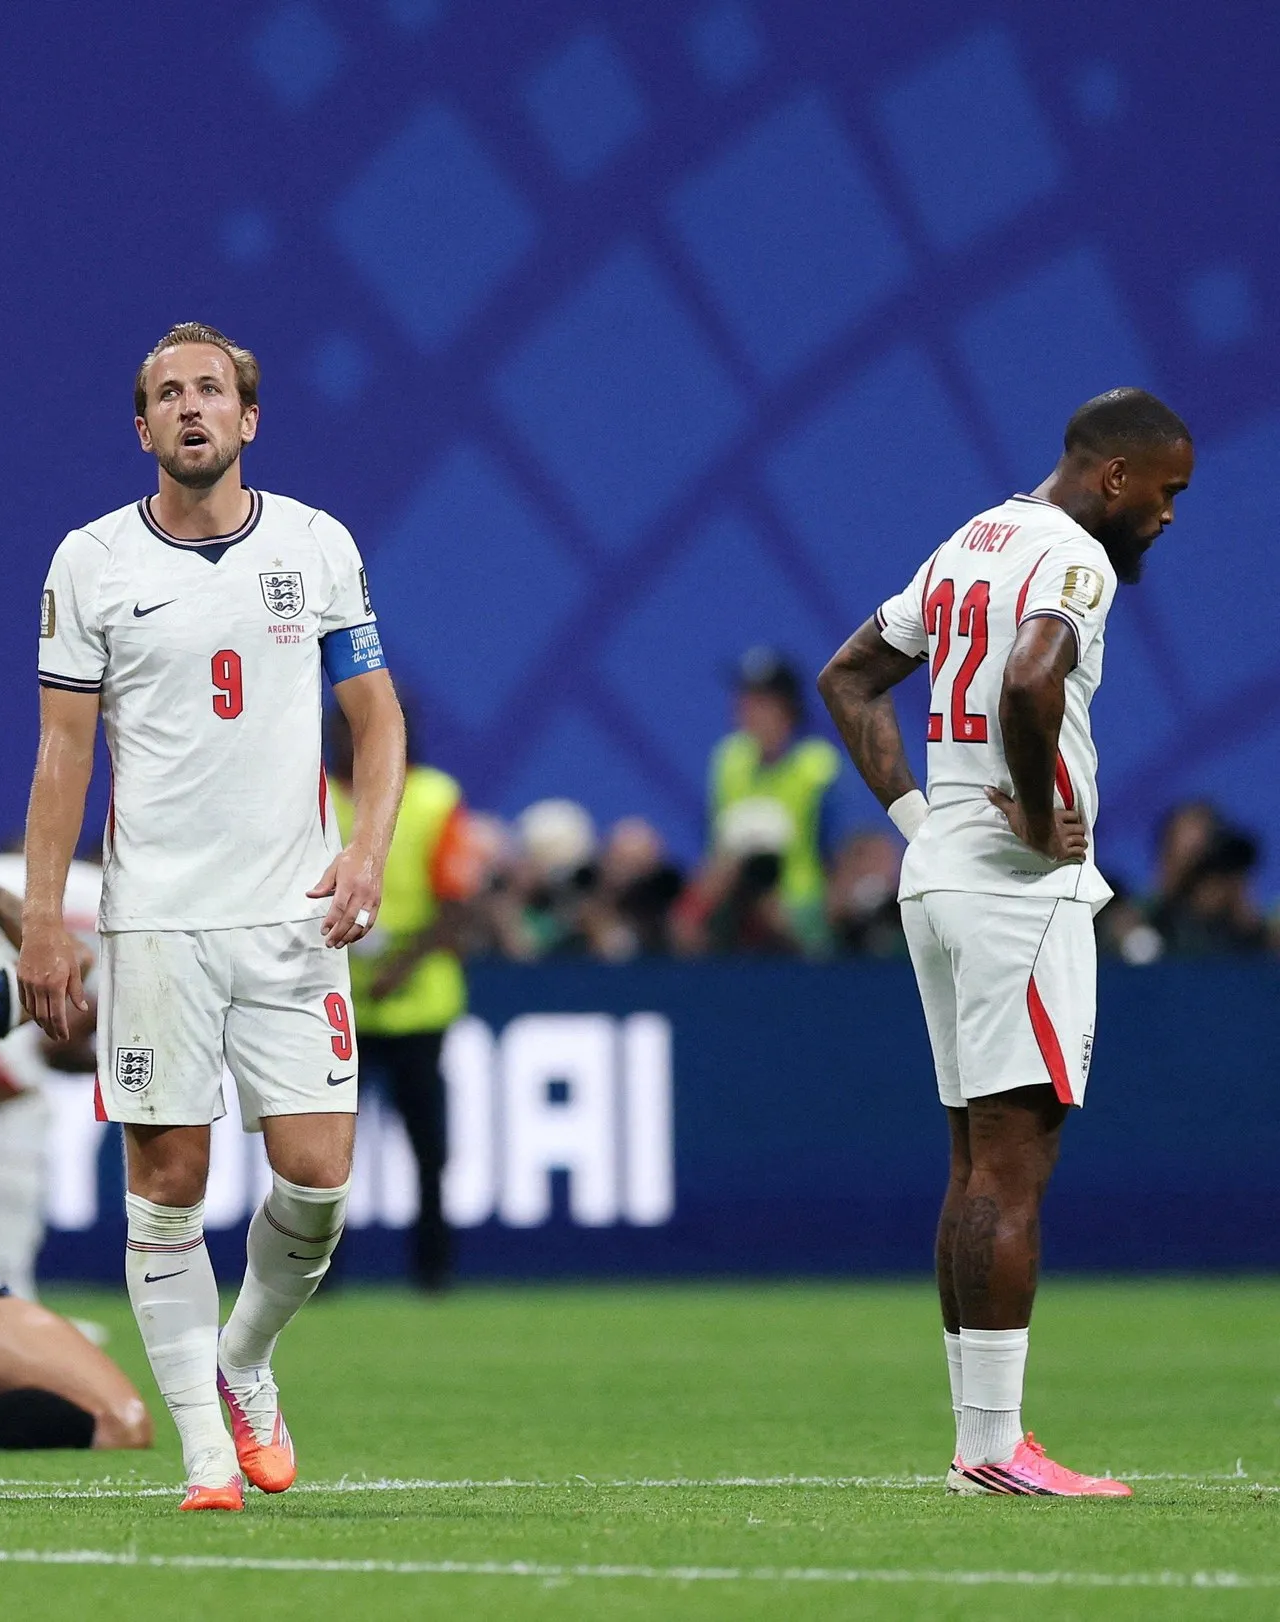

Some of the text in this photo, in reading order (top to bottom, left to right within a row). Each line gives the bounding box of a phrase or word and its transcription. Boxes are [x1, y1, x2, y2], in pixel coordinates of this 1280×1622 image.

[961, 520, 1020, 553] TONEY
[268, 624, 305, 634] ARGENTINA
[351, 633, 380, 651] UNITE
[211, 649, 243, 720] 9
[927, 578, 991, 743] 22
[323, 992, 352, 1061] 9
